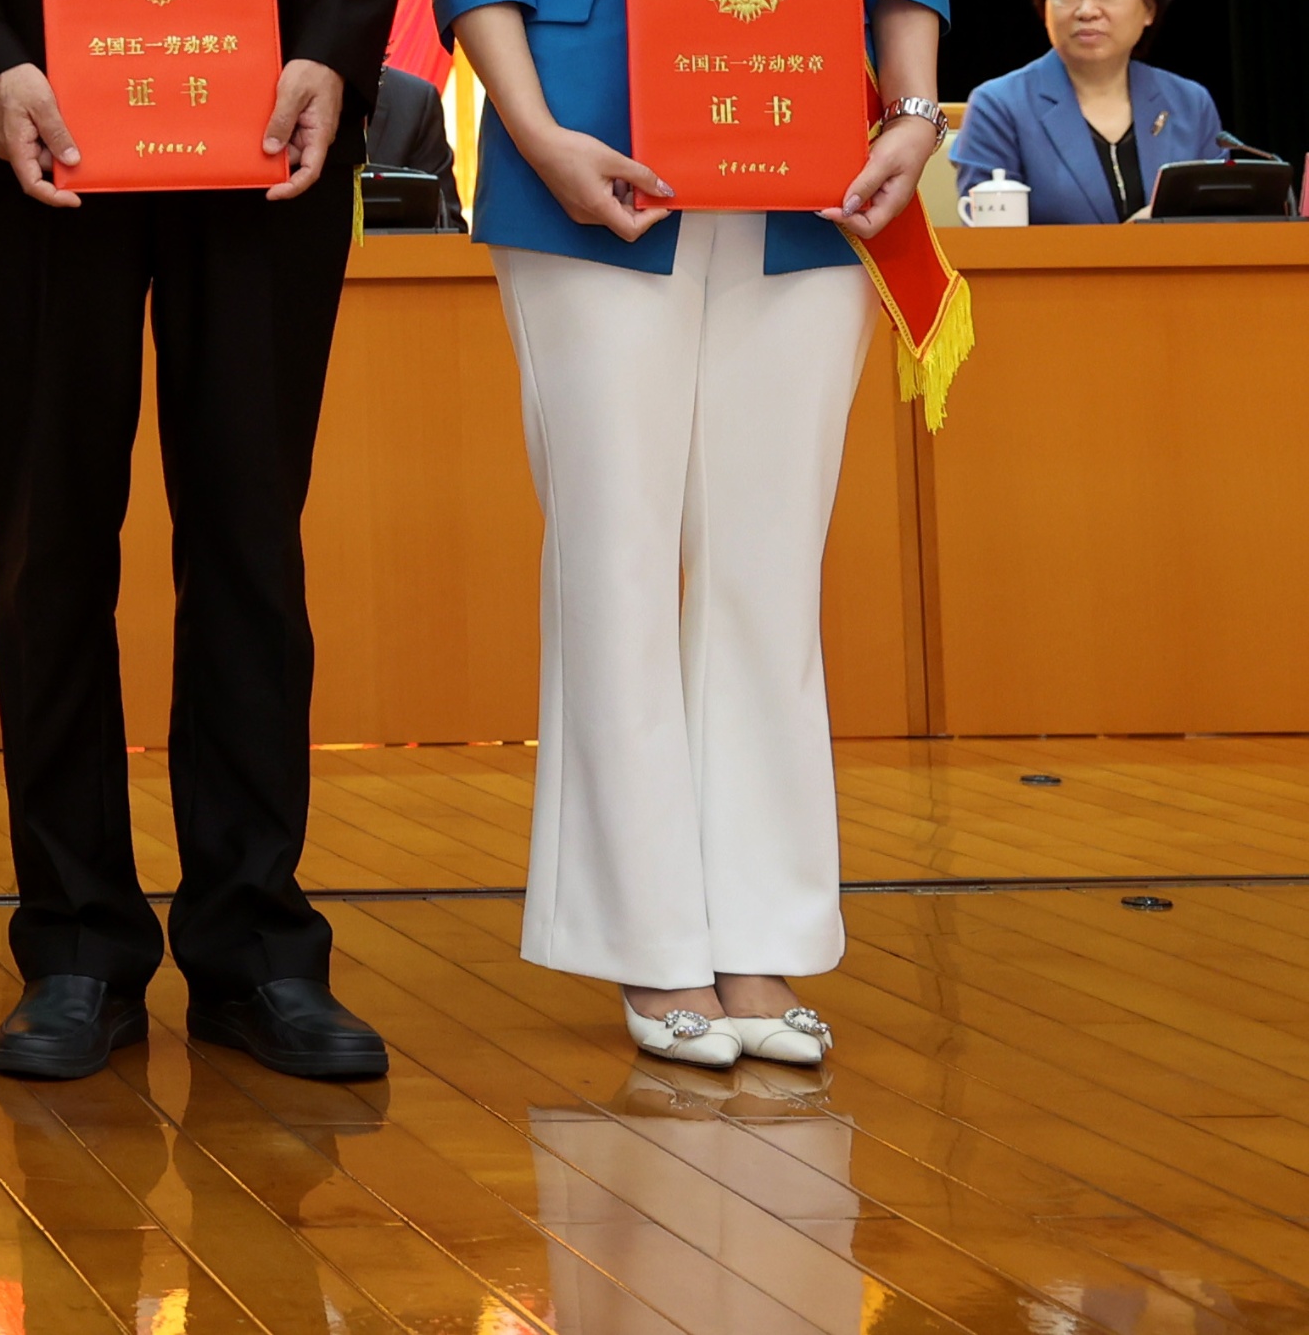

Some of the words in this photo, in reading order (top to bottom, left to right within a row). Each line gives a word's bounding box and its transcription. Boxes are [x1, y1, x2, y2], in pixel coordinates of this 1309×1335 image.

[88, 34, 239, 57] 全国五一劳动奖章
[673, 52, 825, 74] 全国五一劳动奖章
